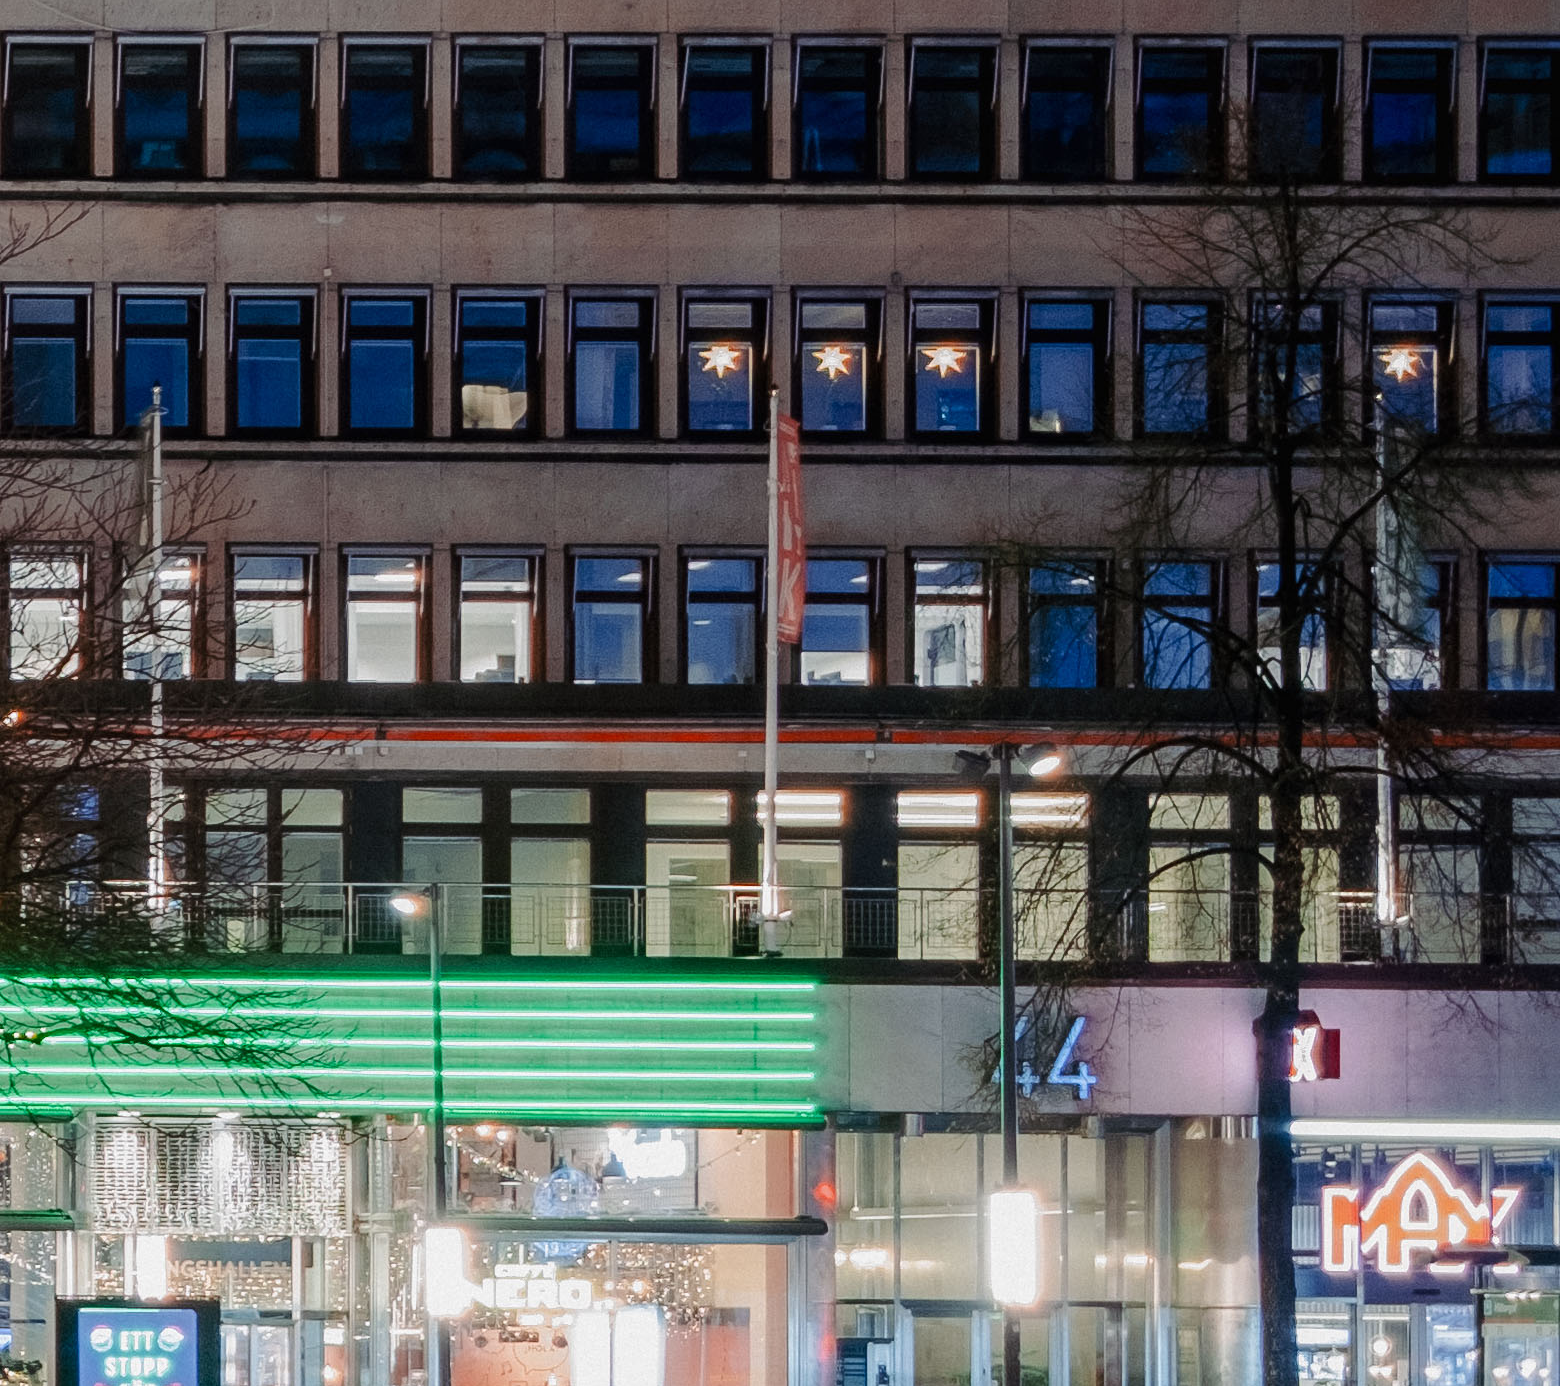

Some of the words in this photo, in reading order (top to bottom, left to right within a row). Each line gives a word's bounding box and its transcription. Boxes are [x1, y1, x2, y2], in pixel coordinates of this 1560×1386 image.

[1322, 1153, 1520, 1273] MAX
[119, 1330, 155, 1352] ETT
[104, 1356, 170, 1378] STOPP
